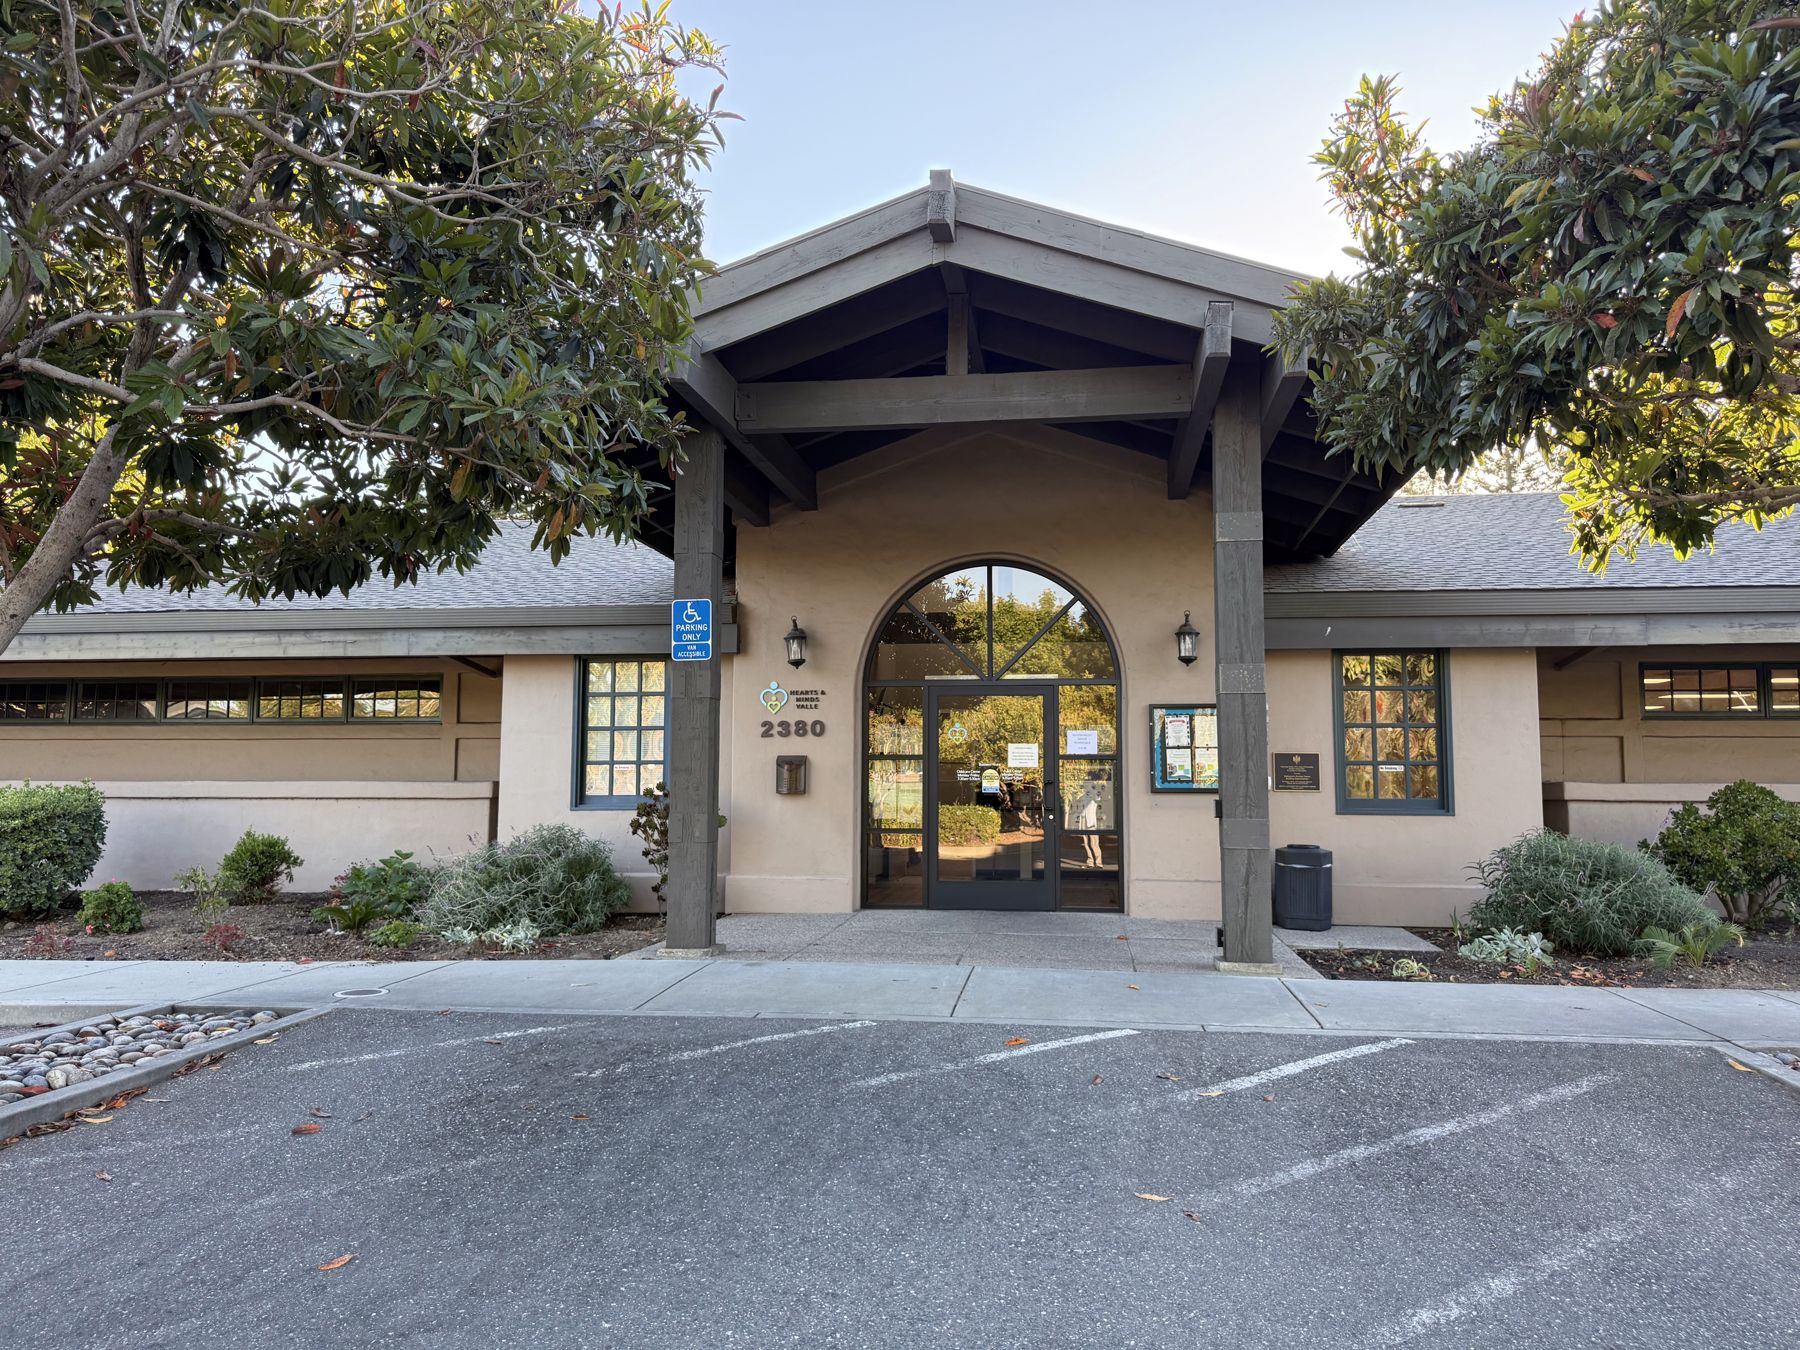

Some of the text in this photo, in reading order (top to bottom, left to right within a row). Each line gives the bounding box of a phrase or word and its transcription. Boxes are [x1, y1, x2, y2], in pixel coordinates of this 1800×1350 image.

[675, 623, 708, 632] PARKING
[682, 633, 702, 641] ONLY
[677, 650, 706, 658] ACCESSIBLE
[760, 719, 826, 738] 2380
